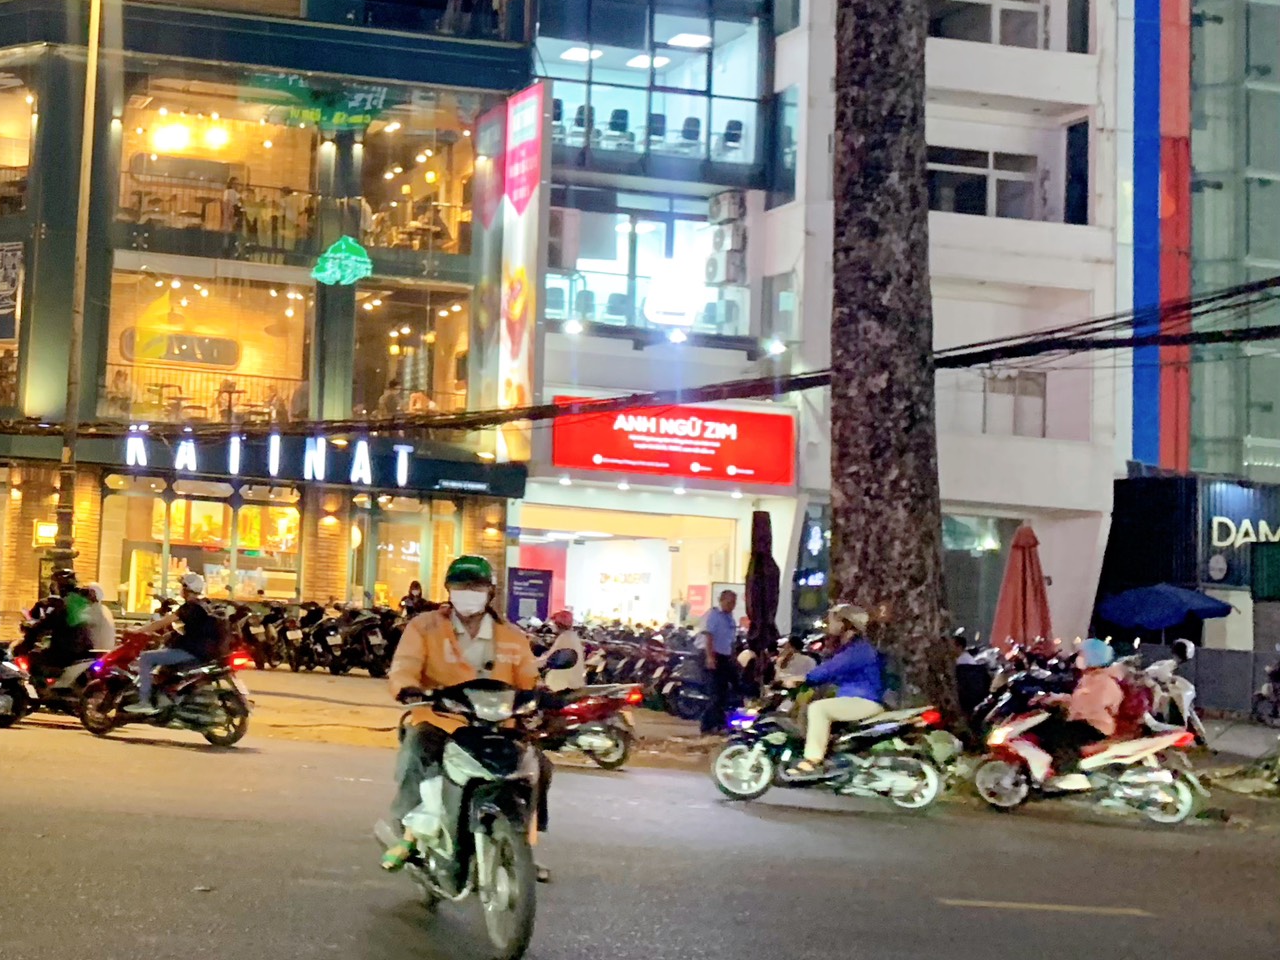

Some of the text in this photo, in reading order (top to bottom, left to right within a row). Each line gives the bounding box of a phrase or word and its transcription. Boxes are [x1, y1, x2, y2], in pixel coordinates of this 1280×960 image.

[613, 414, 737, 440] ANH NGỮ ZIM
